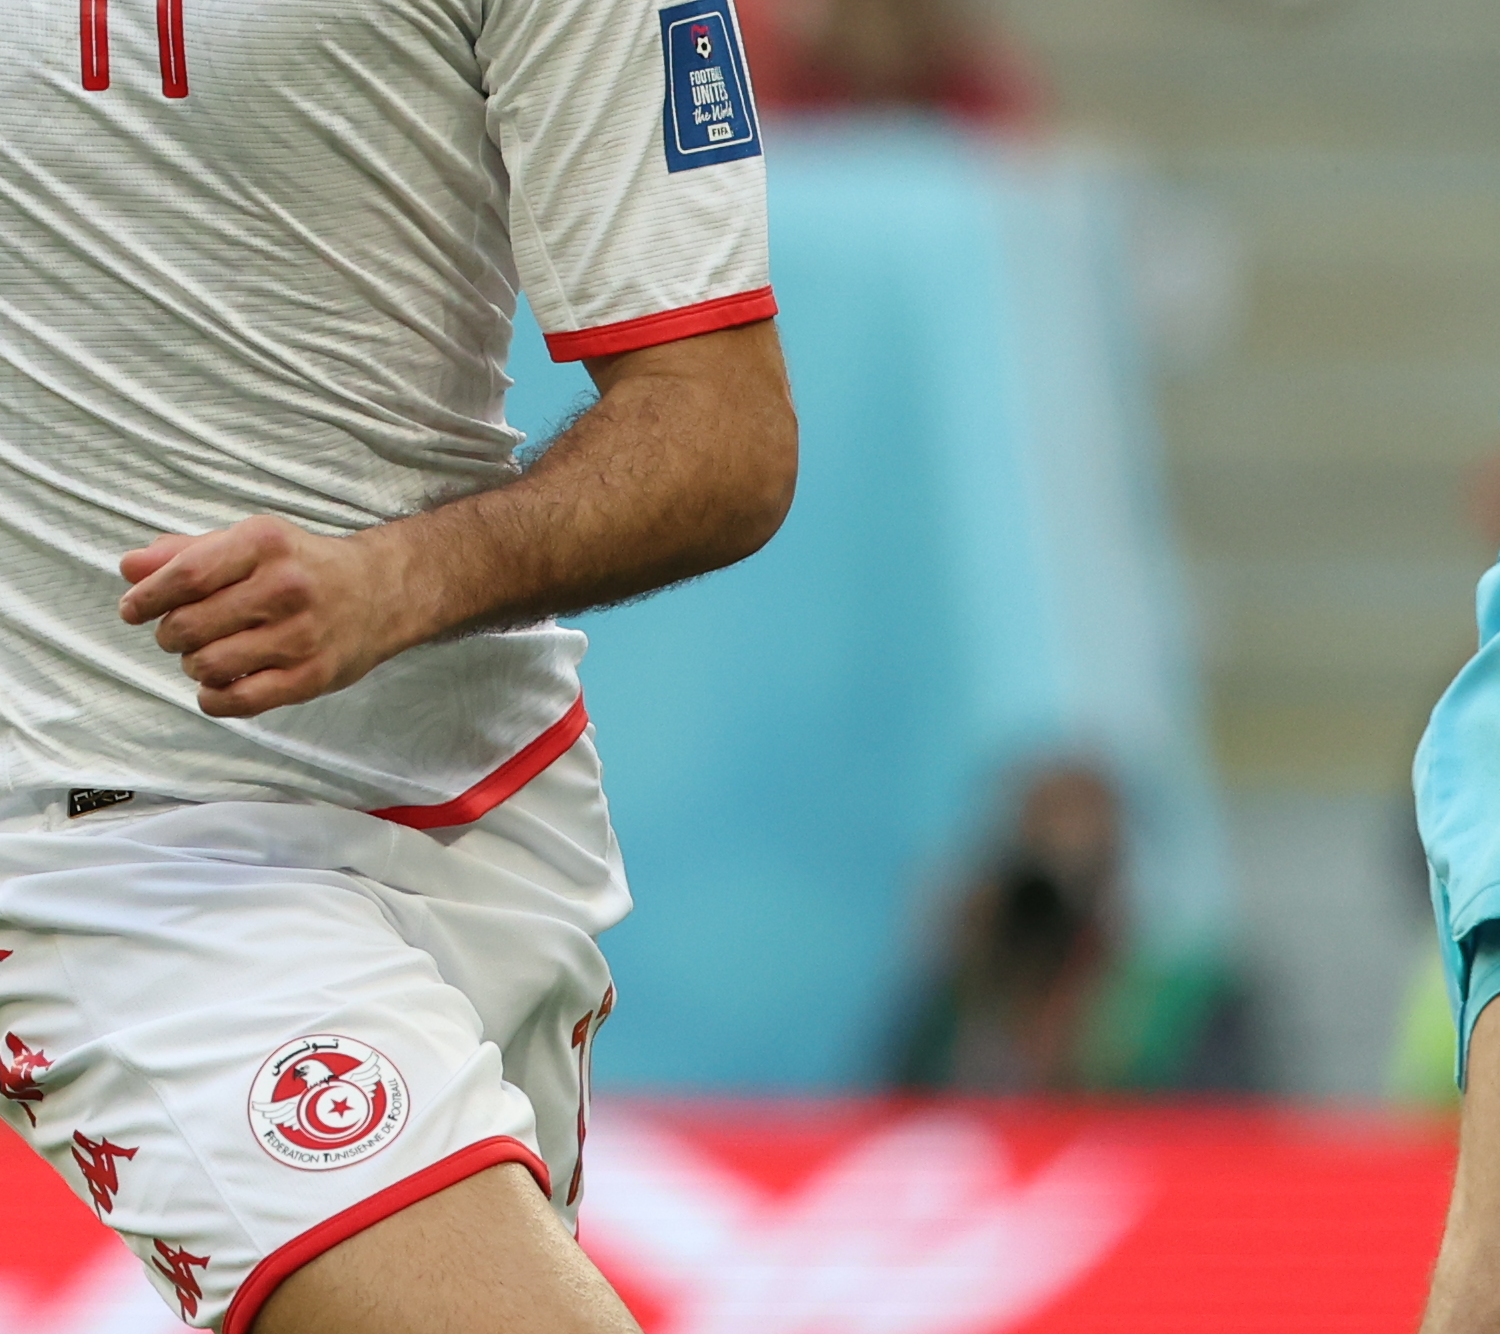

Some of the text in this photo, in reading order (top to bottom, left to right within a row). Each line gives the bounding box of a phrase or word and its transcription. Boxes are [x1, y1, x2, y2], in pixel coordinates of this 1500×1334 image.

[692, 106, 711, 125] the
[711, 127, 729, 138] FIFA
[263, 1077, 403, 1163] FEDERATION TUNISIENNE DE FOOTBALL
